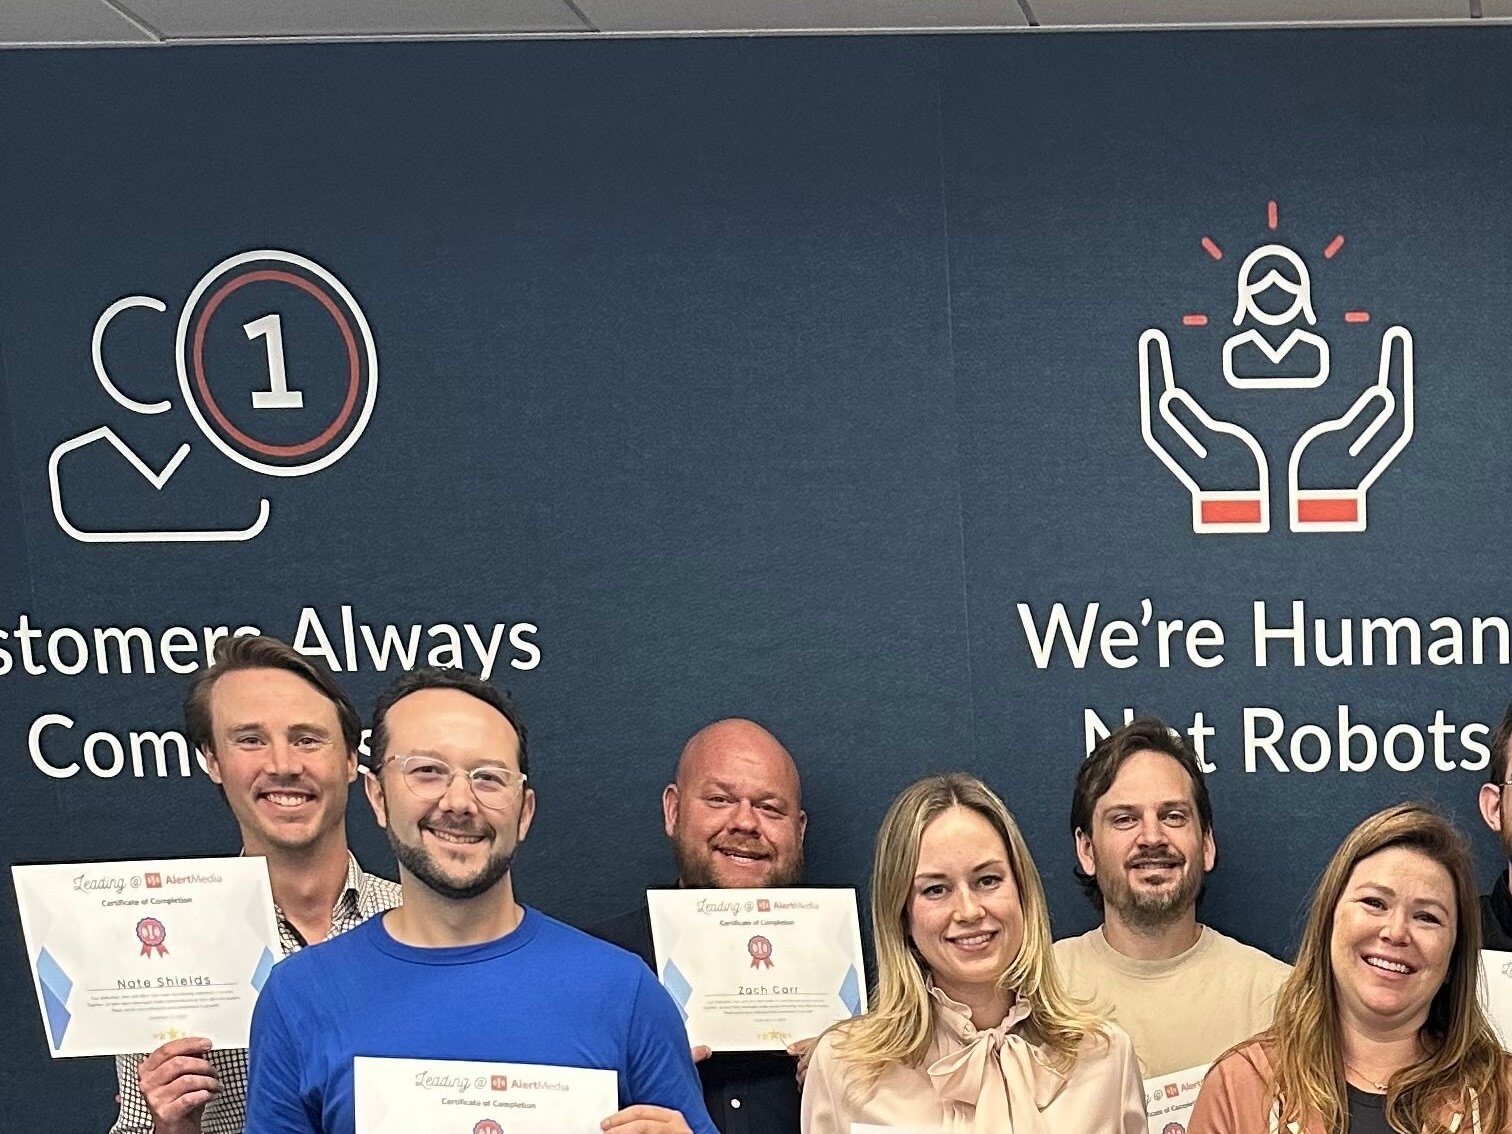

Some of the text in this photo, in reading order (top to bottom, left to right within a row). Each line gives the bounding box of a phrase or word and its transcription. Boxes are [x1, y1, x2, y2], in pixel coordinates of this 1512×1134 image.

[243, 314, 303, 408] 1
[293, 605, 541, 680] Always
[1017, 598, 1225, 668] We're
[28, 713, 210, 778] Com
[1084, 705, 1491, 773] Nt Robots
[73, 874, 222, 894] Leading @ AlertMedia
[697, 898, 742, 916] Leading
[745, 902, 754, 912] @
[117, 976, 210, 989] Nate Shields
[739, 986, 799, 995] Zach Carr
[415, 1071, 569, 1092] Leading @ AlertMedia
